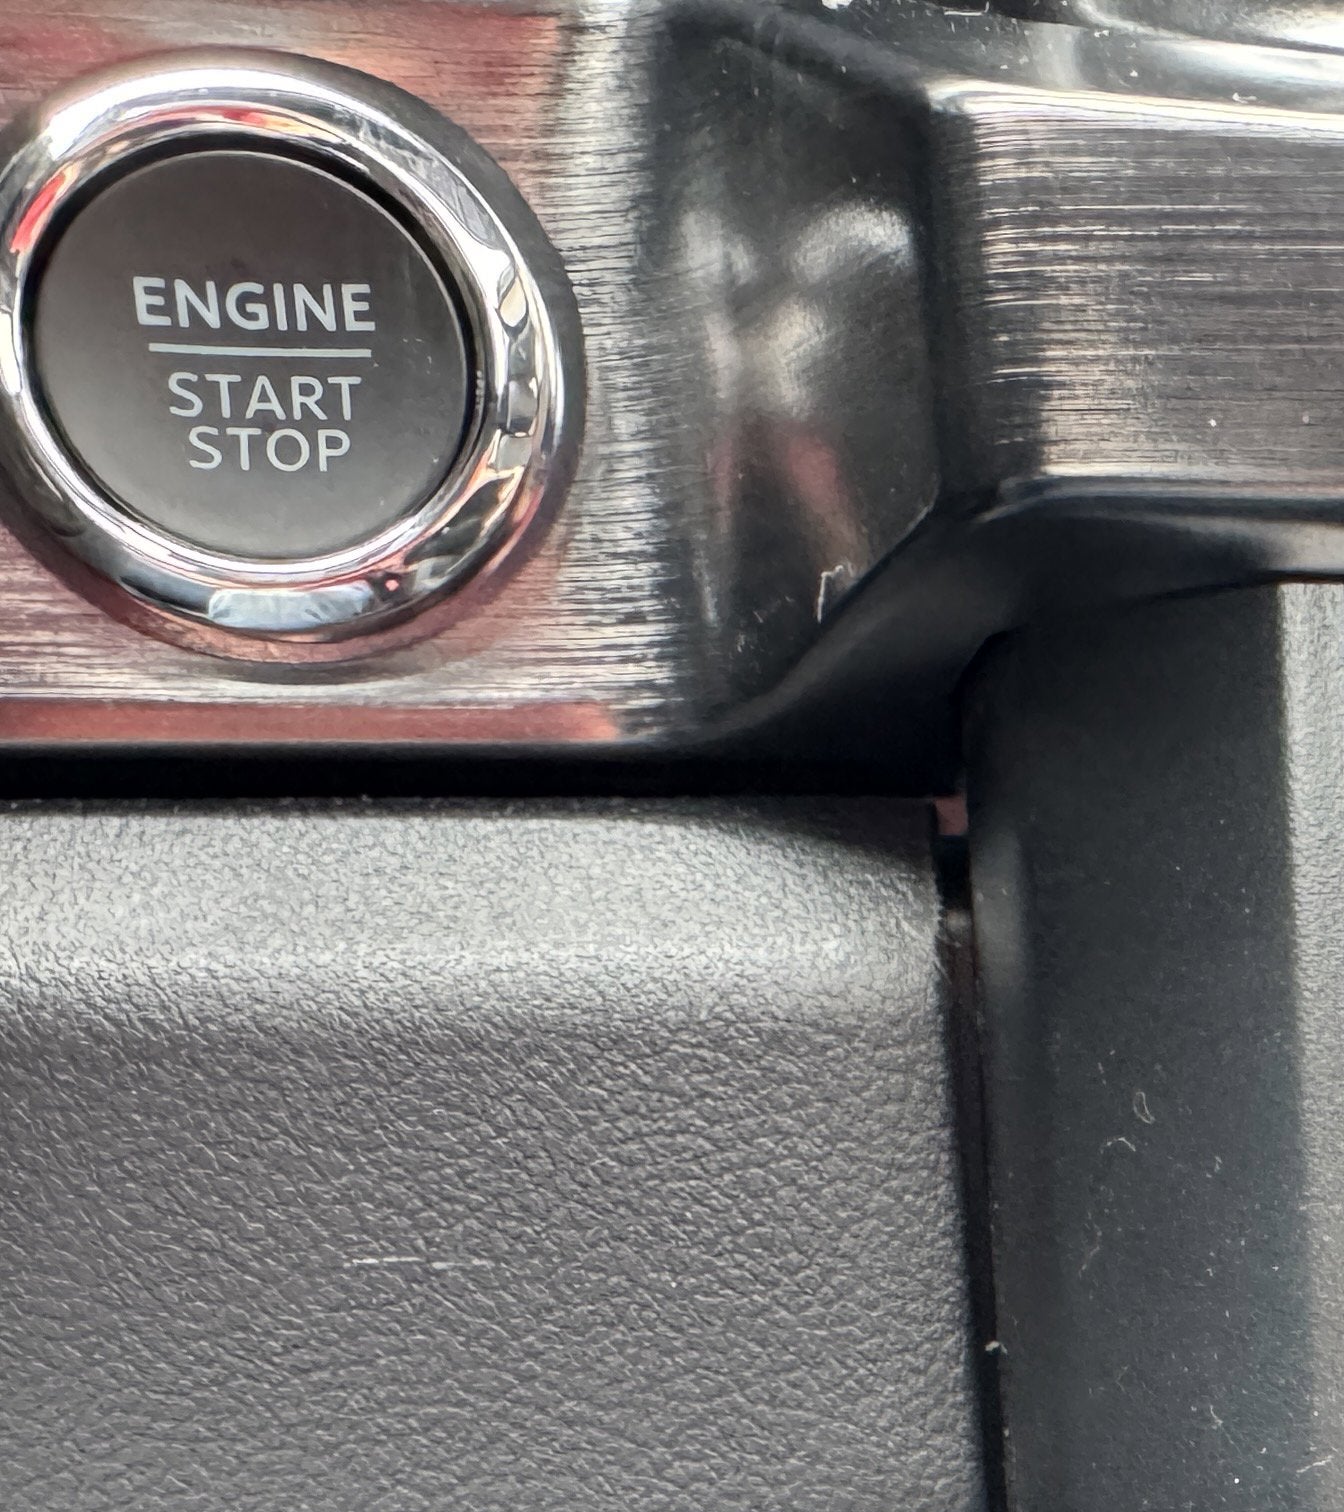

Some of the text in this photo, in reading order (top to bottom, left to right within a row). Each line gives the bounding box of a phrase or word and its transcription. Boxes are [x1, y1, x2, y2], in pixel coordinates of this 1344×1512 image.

[132, 275, 376, 332] ENGINE
[167, 371, 362, 421] START
[188, 426, 351, 473] STOP
